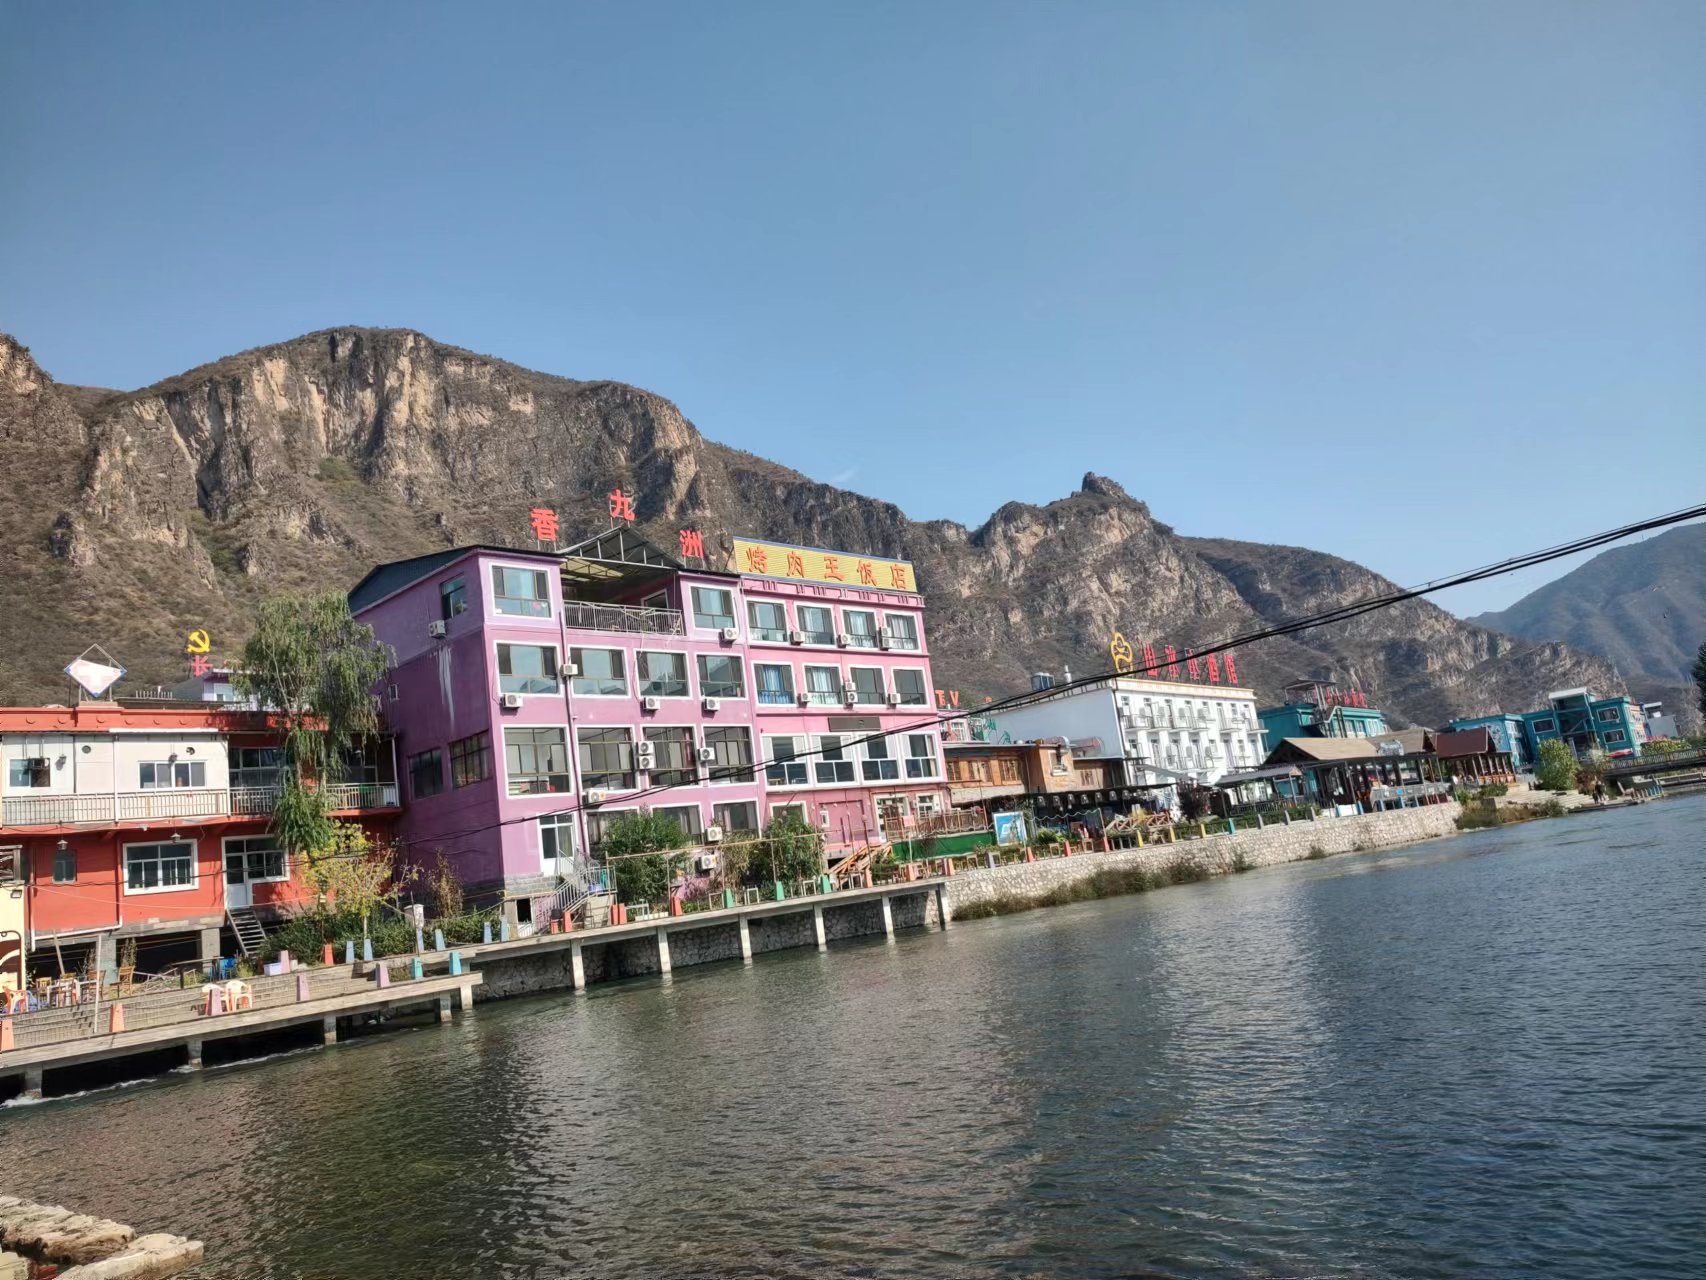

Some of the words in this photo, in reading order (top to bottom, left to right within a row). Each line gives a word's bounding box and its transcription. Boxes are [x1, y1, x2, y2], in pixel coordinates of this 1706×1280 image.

[746, 546, 907, 589] 烤肉王饭店
